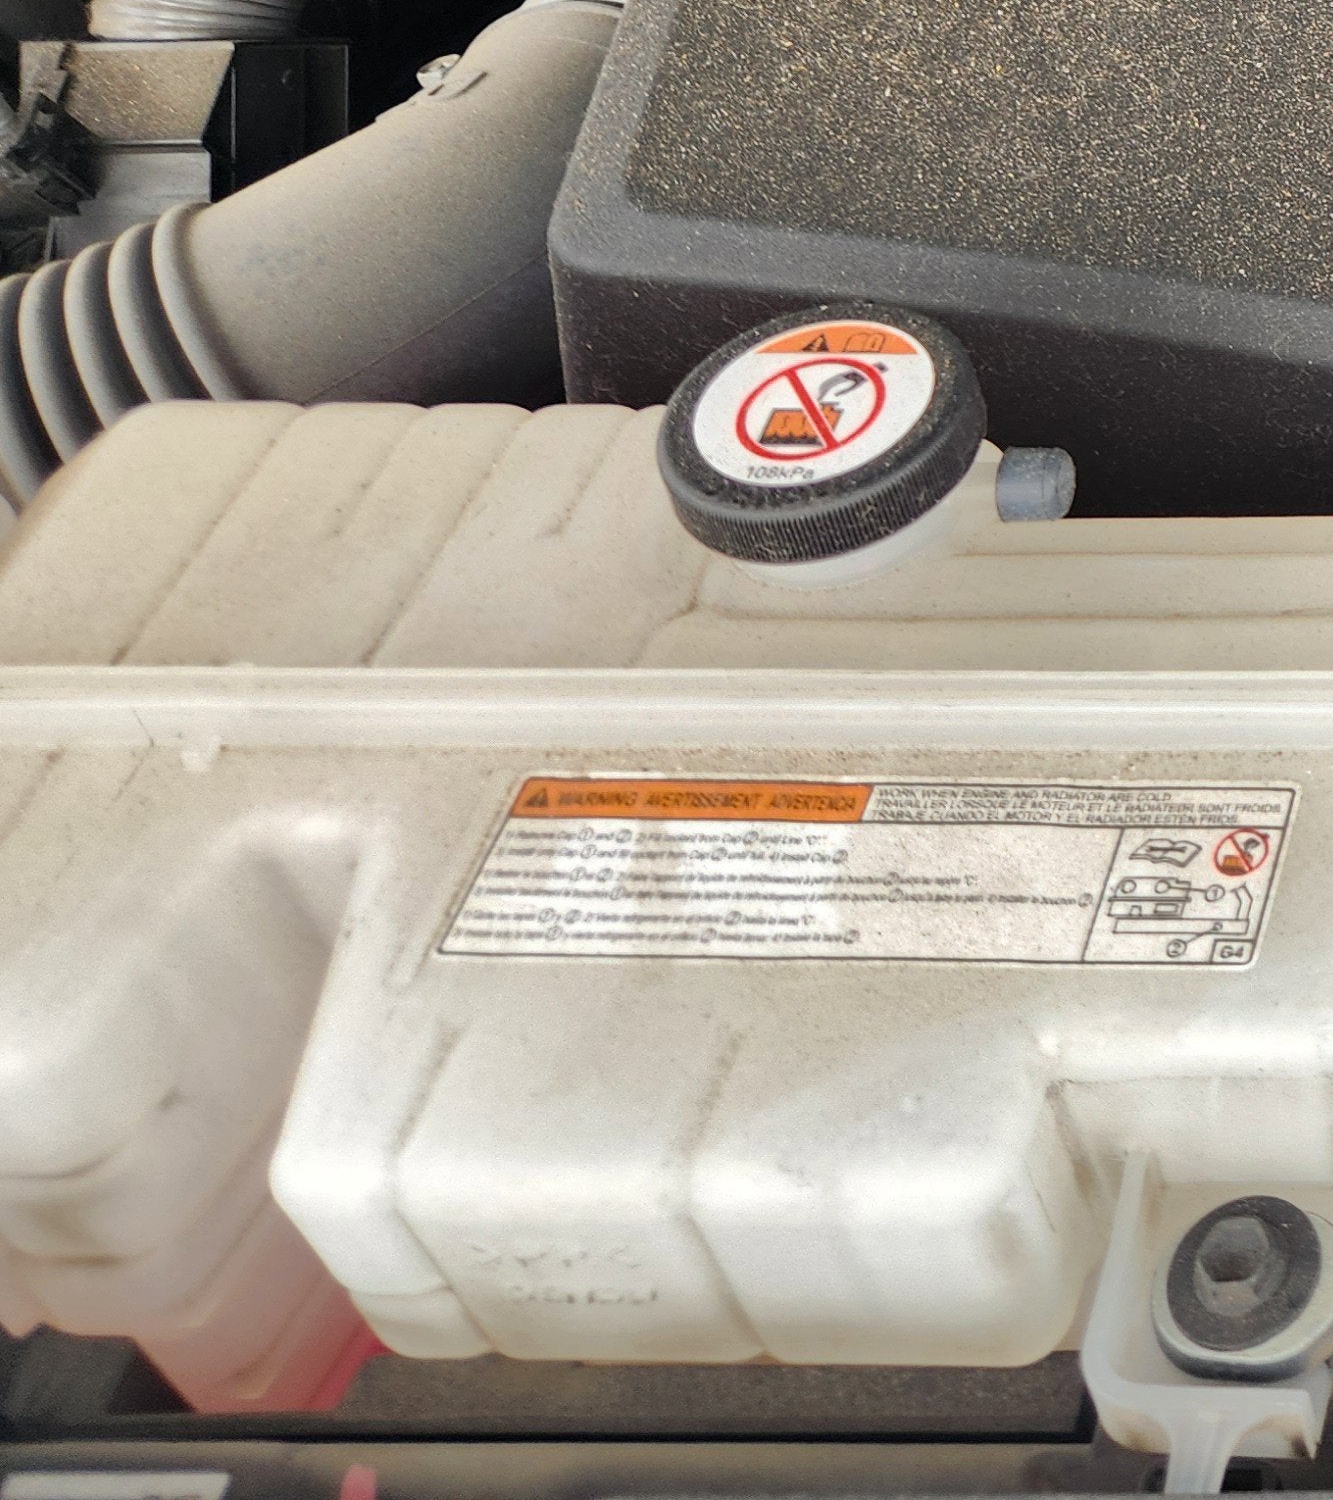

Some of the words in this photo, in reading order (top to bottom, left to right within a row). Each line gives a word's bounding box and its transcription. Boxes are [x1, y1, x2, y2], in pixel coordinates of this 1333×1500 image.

[746, 466, 815, 482] 108kPa
[558, 790, 636, 808] WARNING
[646, 791, 763, 810] AVERTISSEMENT
[769, 792, 857, 812] ADVERTENCIA
[879, 788, 917, 798] WORK
[922, 789, 958, 799] WHEN
[961, 789, 1009, 799] ENGINE
[1012, 790, 1038, 799] AND
[1041, 791, 1105, 801] RADIATOR
[1109, 792, 1133, 801] ARE
[876, 798, 947, 809] TRAVAILLER
[1012, 801, 1028, 810] LE
[1031, 801, 1084, 811] MOTEUR
[1088, 803, 1102, 812] ET
[1106, 803, 1121, 812] LE
[1125, 803, 1195, 813] RADIATEUR
[1198, 803, 1231, 813] SONT
[987, 811, 1000, 820] EL
[1006, 811, 1052, 821] MOTOR
[1066, 812, 1080, 822] EL
[1086, 813, 1152, 824] RADIADOR
[1219, 946, 1245, 960] G4
